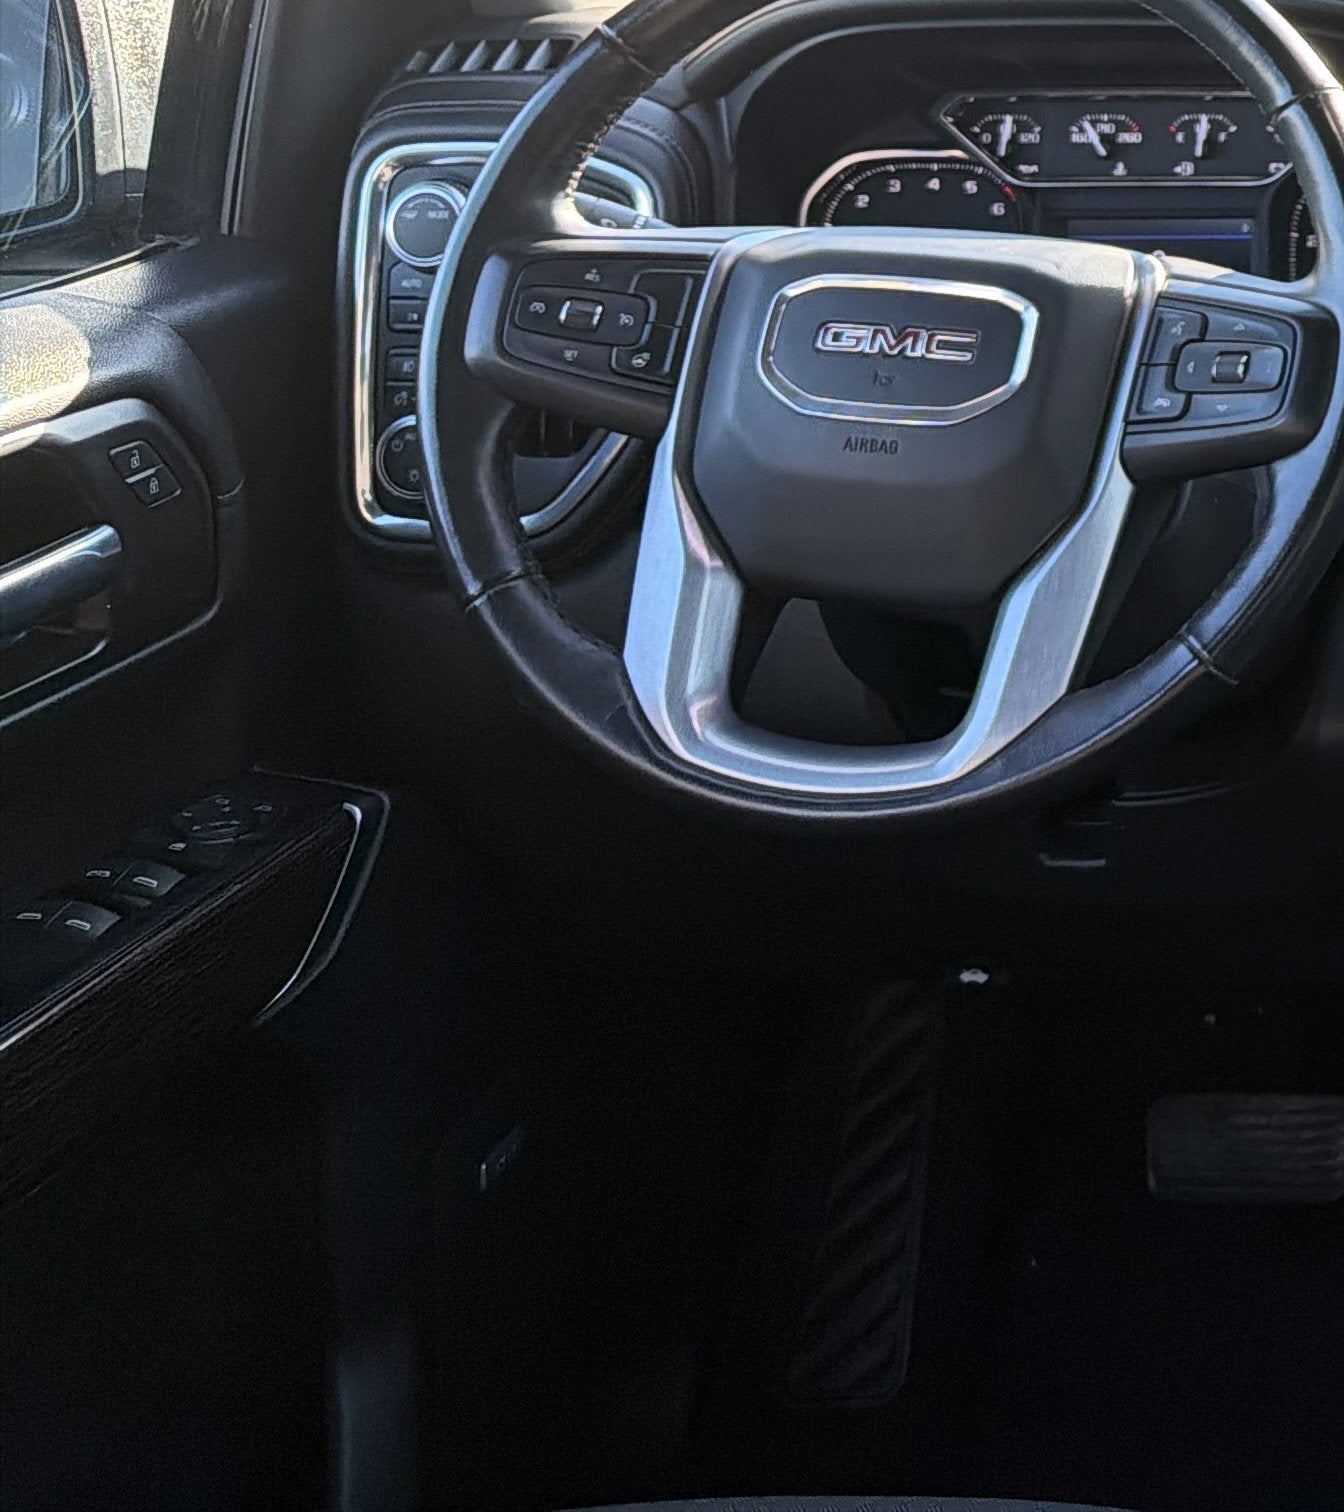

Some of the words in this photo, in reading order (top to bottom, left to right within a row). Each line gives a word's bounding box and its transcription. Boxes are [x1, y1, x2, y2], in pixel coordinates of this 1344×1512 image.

[1019, 132, 1041, 145] 120
[1115, 132, 1143, 144] 260
[853, 194, 870, 209] 2
[887, 178, 901, 193] 3
[924, 177, 941, 192] 4
[962, 180, 978, 195] 5
[990, 202, 1006, 217] 6
[401, 279, 422, 288] AUTO
[815, 321, 977, 361] GMC
[843, 437, 899, 455] AIRBAG
